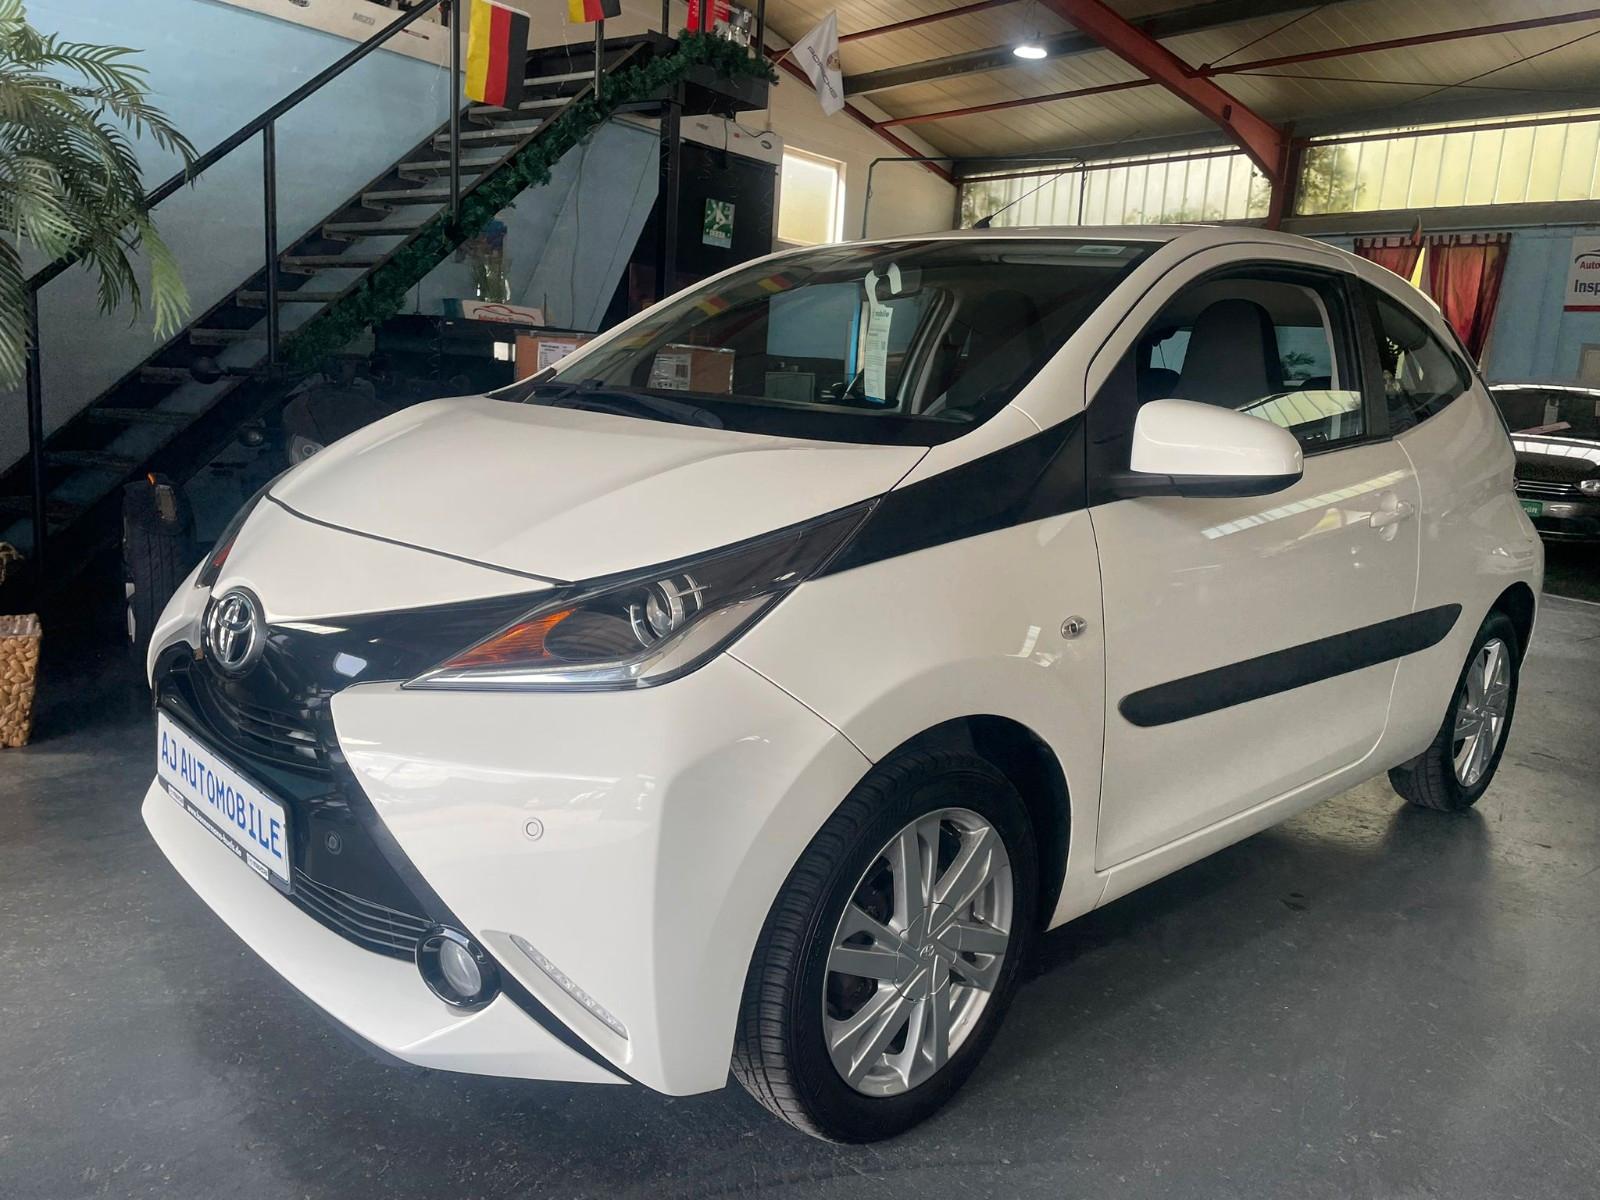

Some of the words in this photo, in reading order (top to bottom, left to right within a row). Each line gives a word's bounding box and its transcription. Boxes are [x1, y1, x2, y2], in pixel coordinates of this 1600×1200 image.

[1575, 279, 1600, 296] Insp
[162, 731, 177, 770] AJ
[181, 747, 282, 858] AUTOMOBILE
